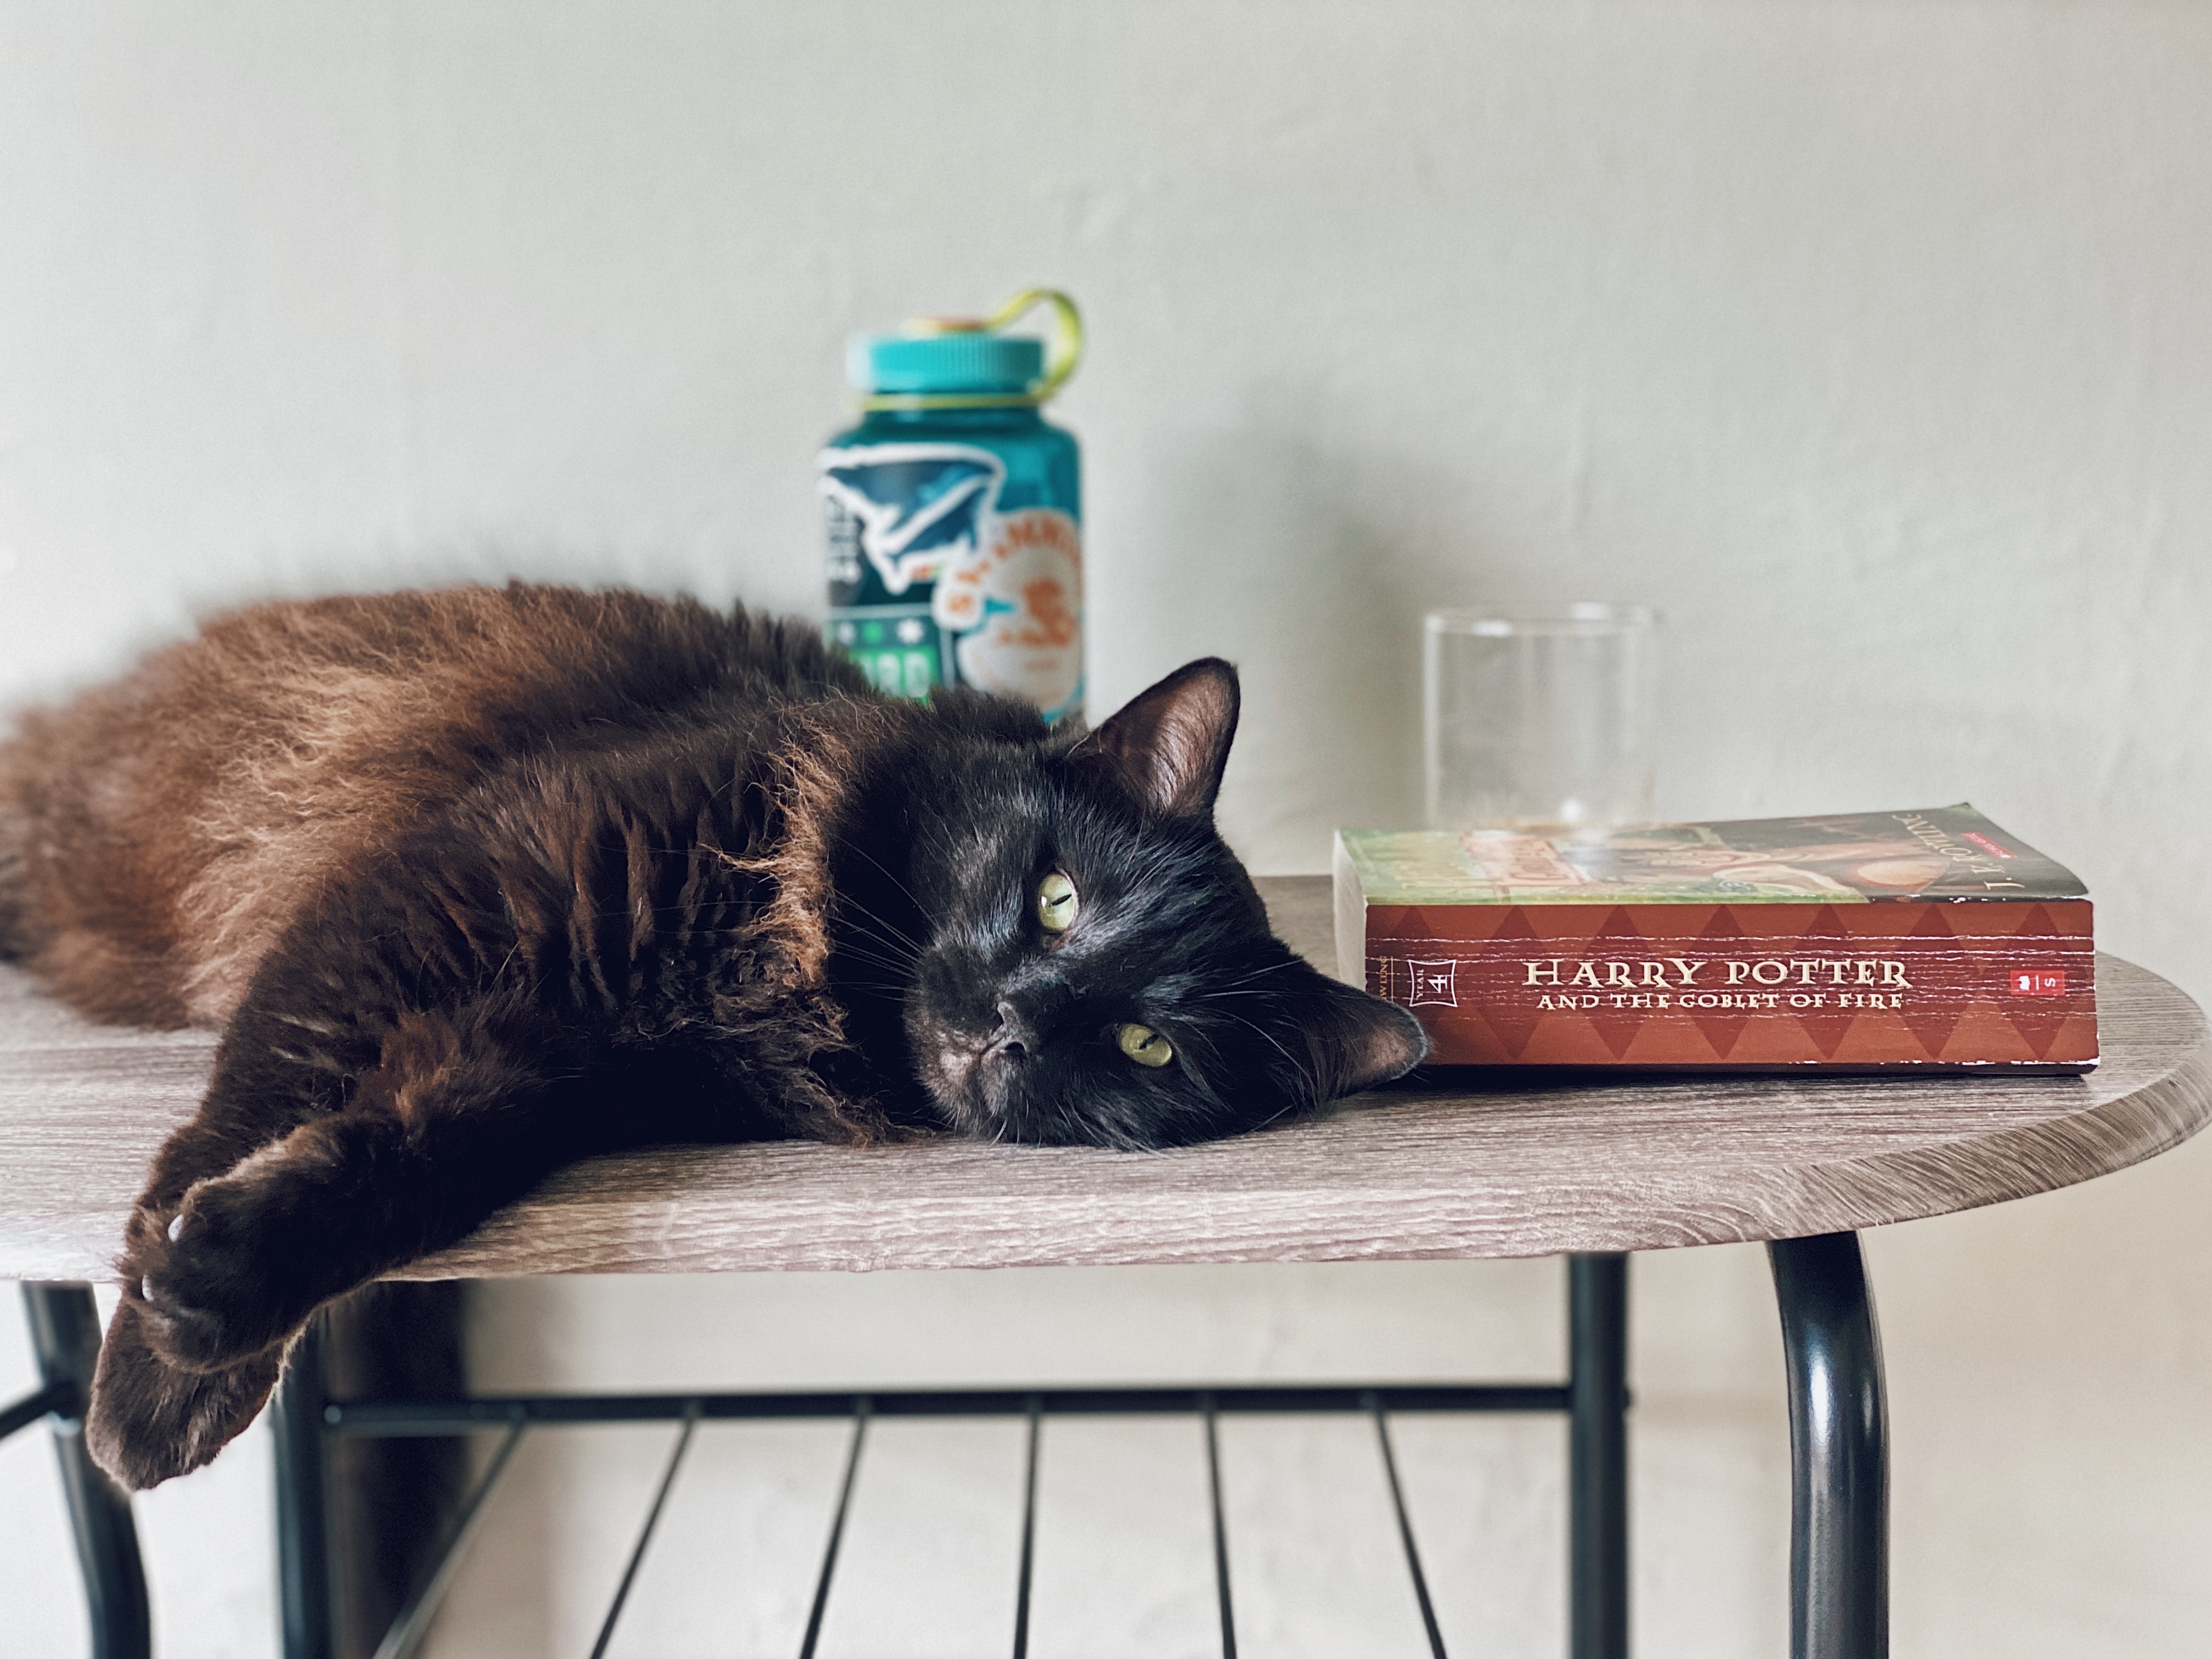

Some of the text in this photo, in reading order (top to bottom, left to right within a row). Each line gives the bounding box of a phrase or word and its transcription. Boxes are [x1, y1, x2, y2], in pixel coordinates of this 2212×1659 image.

[1893, 814, 1986, 862] ROWLING
[1416, 969, 1424, 1000] YEAR
[1427, 974, 1447, 994] 4
[1522, 958, 1913, 988] HARRY POTTER
[1536, 992, 1903, 1010] AND THE GOBLET OF FIRE
